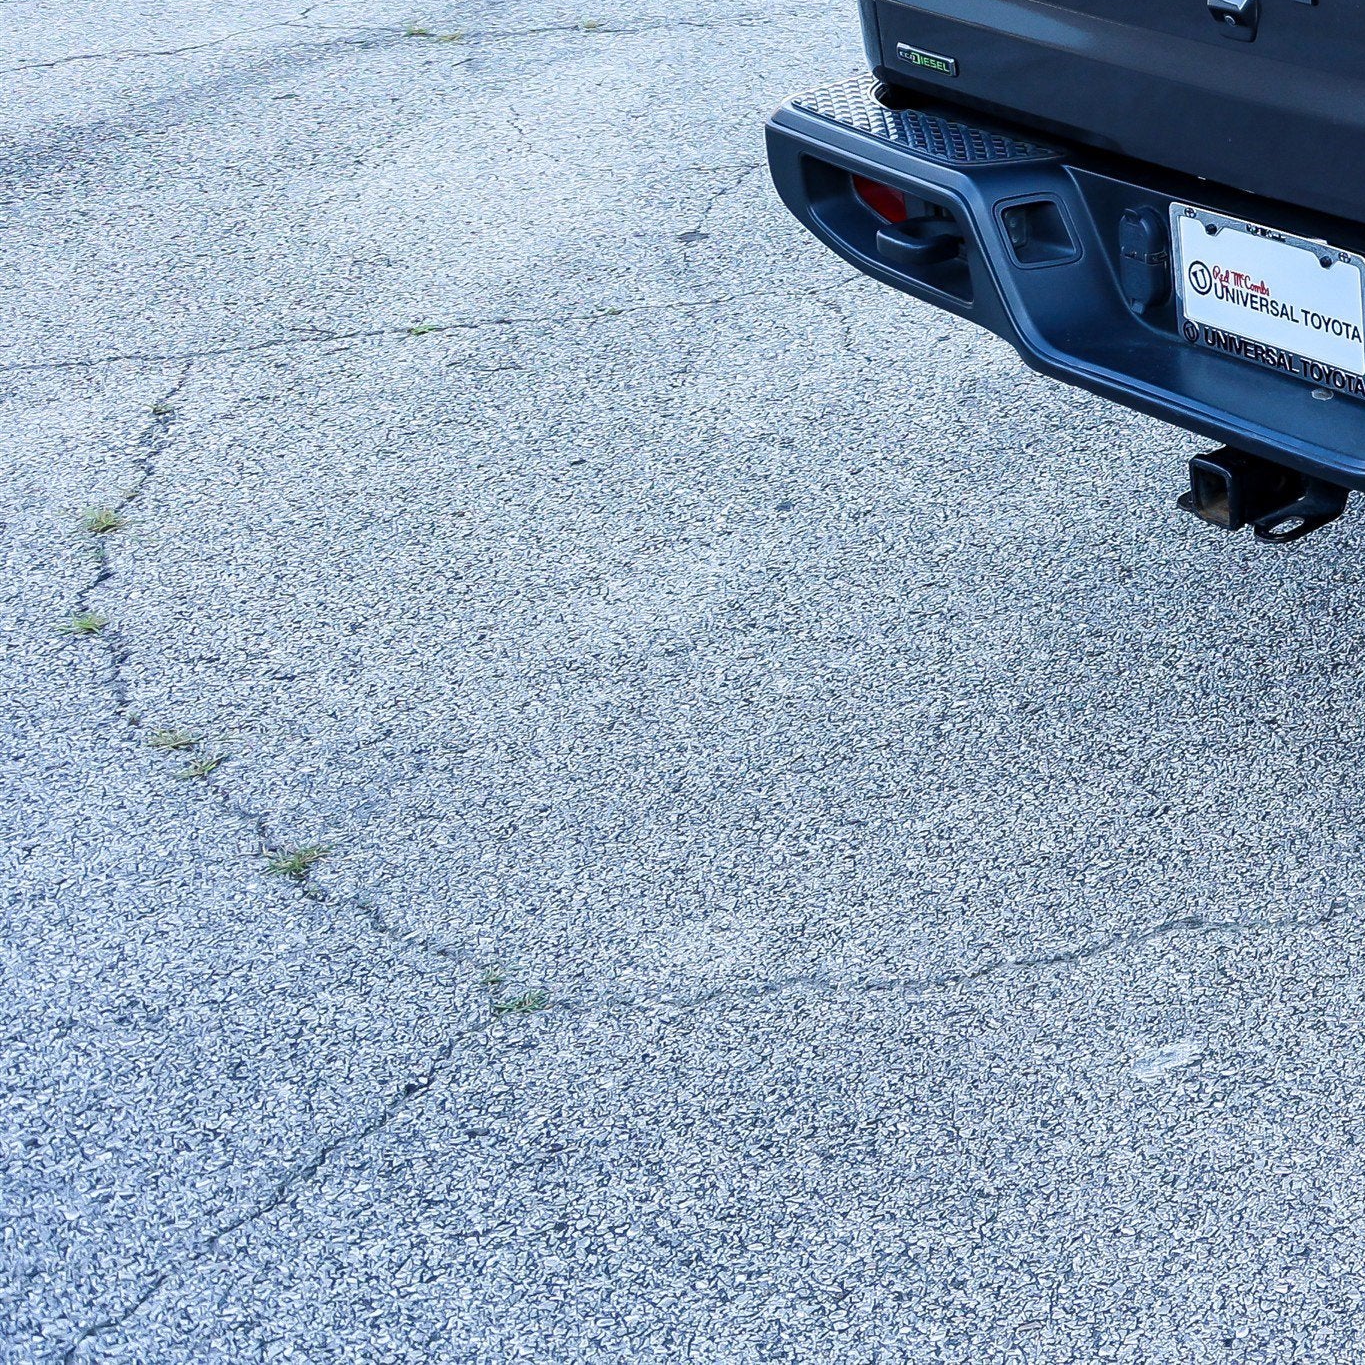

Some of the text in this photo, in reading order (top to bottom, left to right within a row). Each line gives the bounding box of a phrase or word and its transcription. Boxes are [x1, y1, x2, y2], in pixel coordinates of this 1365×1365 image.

[1213, 265, 1229, 285] Red
[1214, 283, 1363, 344] UNIVERSAL TOYOTA
[1204, 326, 1300, 374] UNIVERSAL
